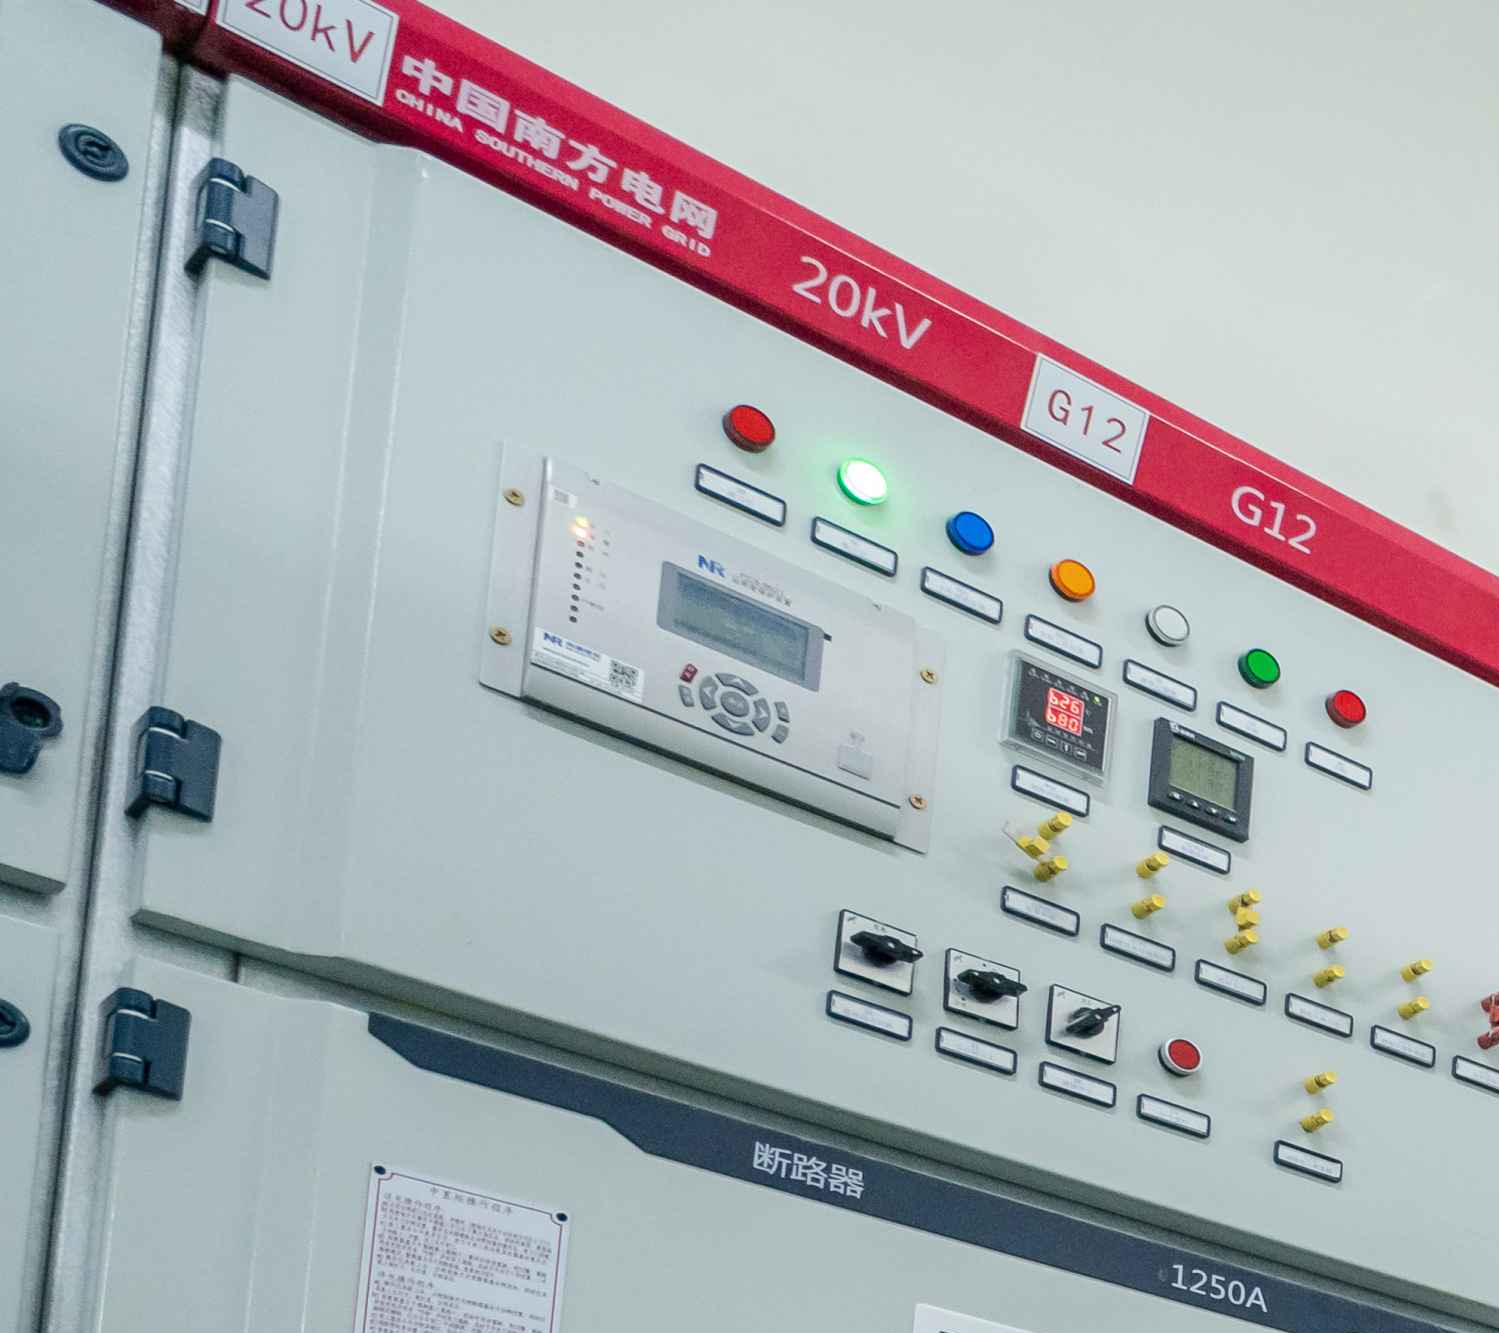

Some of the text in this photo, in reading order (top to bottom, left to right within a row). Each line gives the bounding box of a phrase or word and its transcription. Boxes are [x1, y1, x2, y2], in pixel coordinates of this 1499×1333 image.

[396, 89, 712, 257] CHINA SOUTHERN POWER GRID
[402, 58, 718, 240] 中国南方电网
[792, 256, 932, 350] 20kV
[1047, 388, 1127, 454] G12
[1230, 485, 1318, 555] G12
[751, 1140, 866, 1199] 断路器
[1169, 1263, 1268, 1313] 1250A
